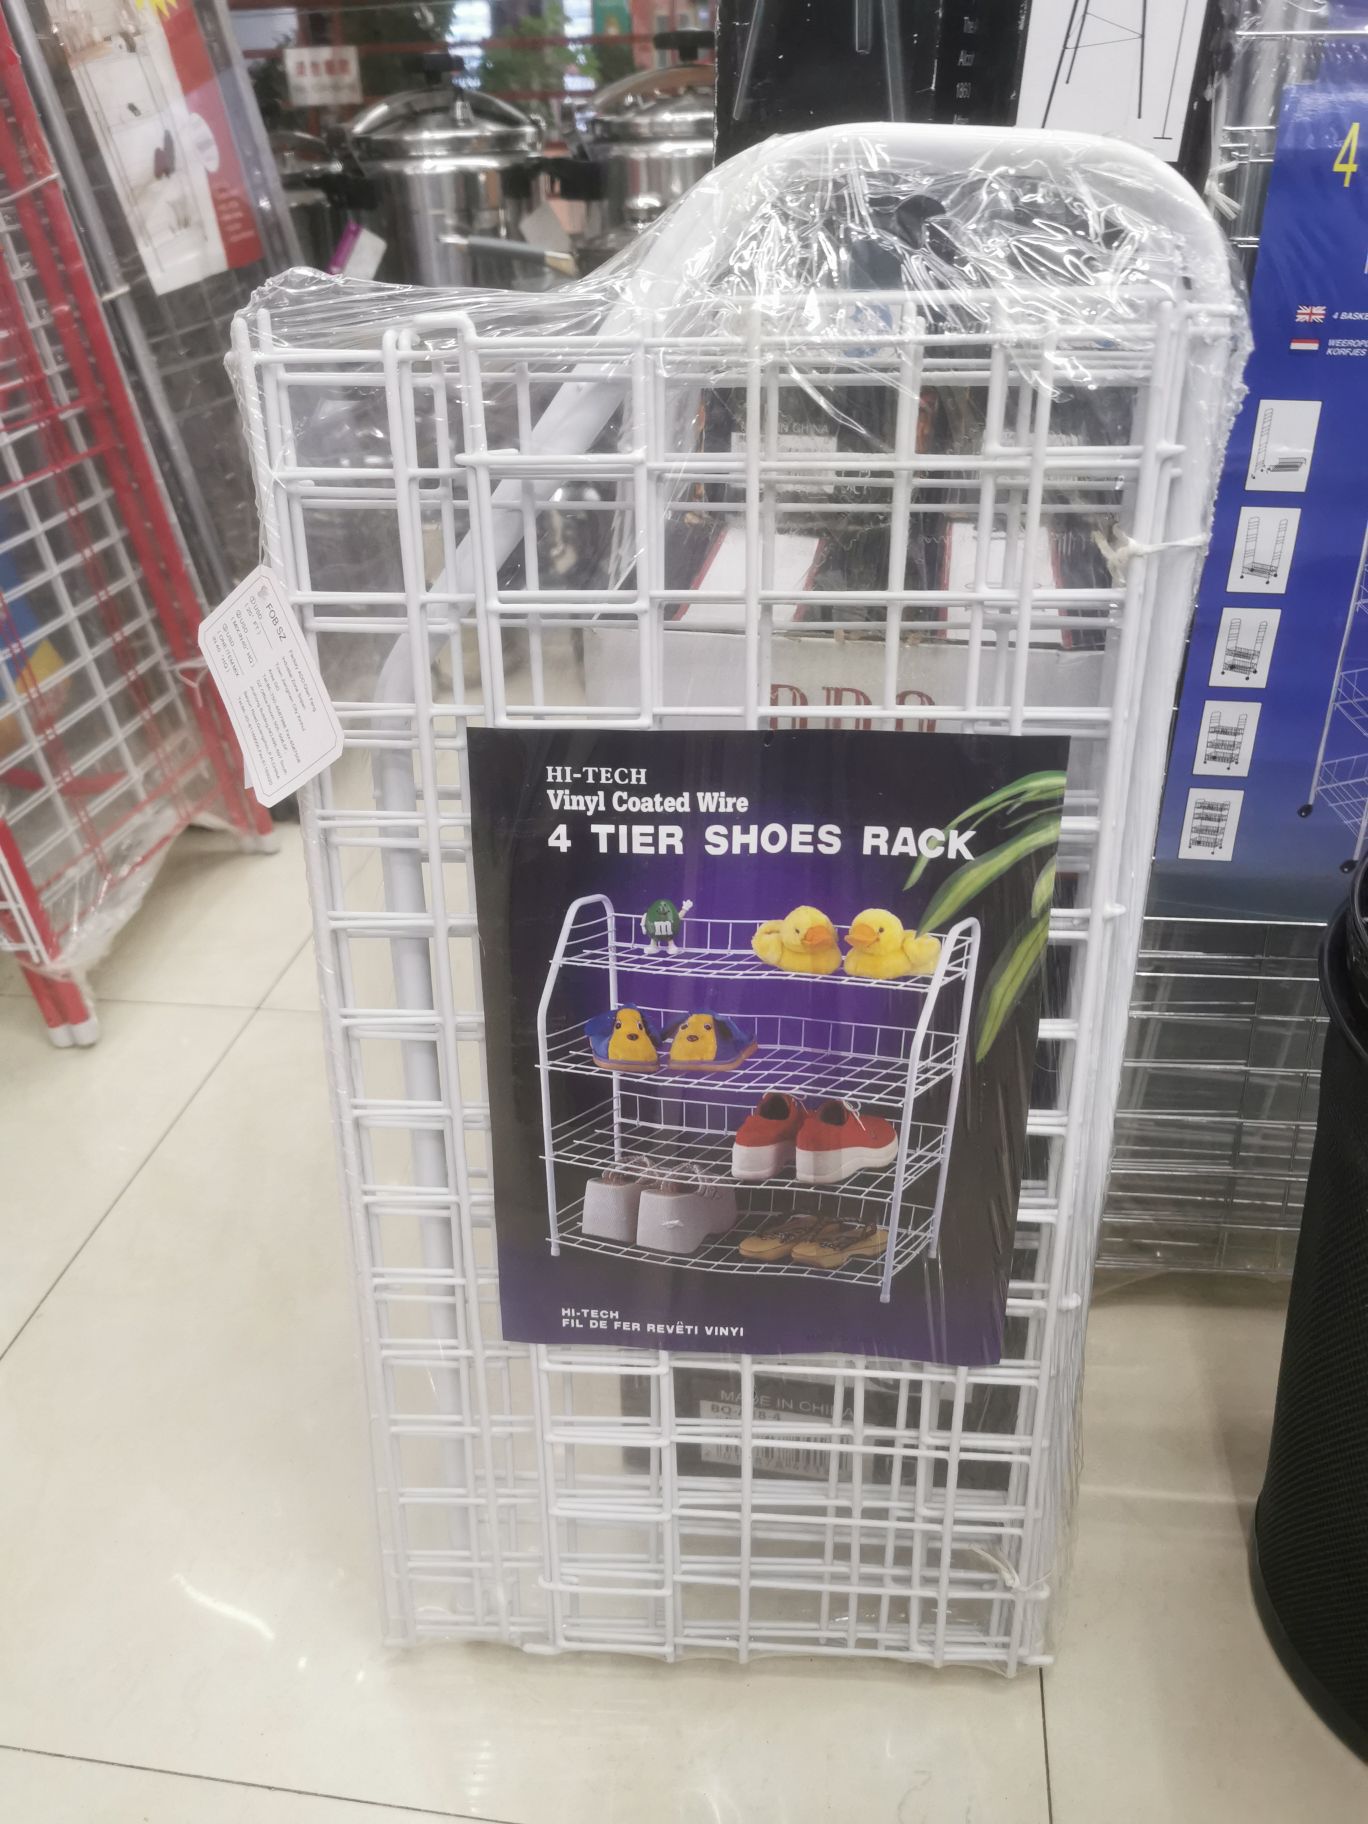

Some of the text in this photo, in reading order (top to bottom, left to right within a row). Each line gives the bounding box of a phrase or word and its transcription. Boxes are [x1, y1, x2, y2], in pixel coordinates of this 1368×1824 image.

[1333, 122, 1361, 188] 4
[264, 601, 280, 628] FOB
[546, 766, 647, 785] HI-TECH
[546, 789, 749, 816] Vinyl Coated Wire
[548, 822, 976, 860] 4 TIER SHOES RACK
[561, 1307, 619, 1319] HI-TECH
[562, 1318, 744, 1337] FIL DE FER REVÊTI VINYI
[776, 1397, 794, 1409] IN
[799, 1400, 855, 1418] CHIA
